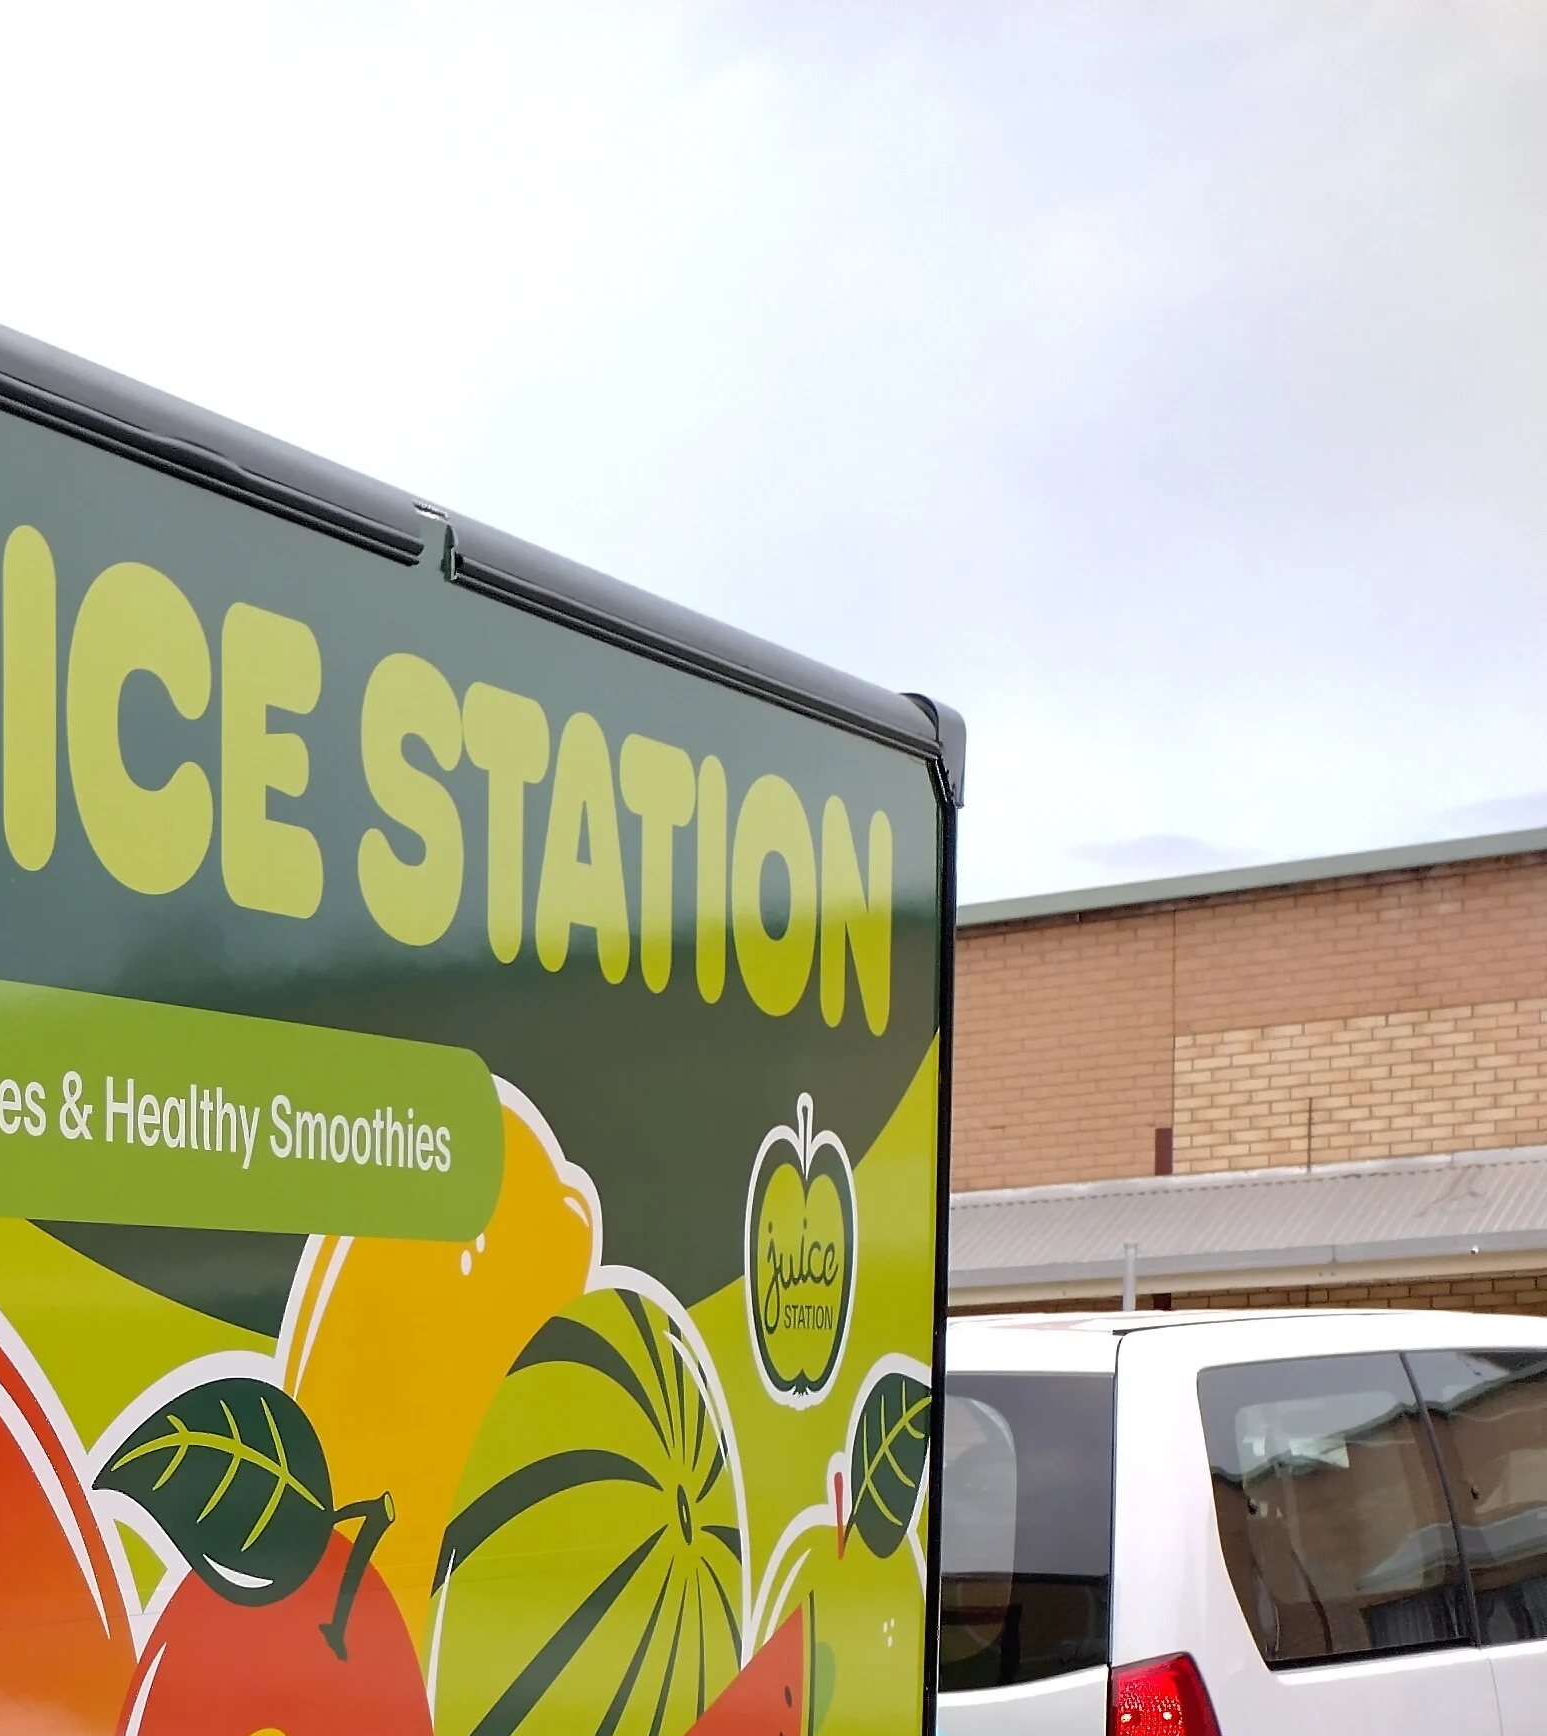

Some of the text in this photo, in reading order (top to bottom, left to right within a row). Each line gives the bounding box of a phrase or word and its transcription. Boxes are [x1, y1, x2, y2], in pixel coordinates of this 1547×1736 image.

[357, 652, 893, 1038] STATION
[58, 1070, 93, 1141] &
[105, 1076, 260, 1170] Healthy
[269, 1095, 454, 1175] Smoothies
[763, 1216, 840, 1336] juice
[783, 1303, 835, 1331] STATION
